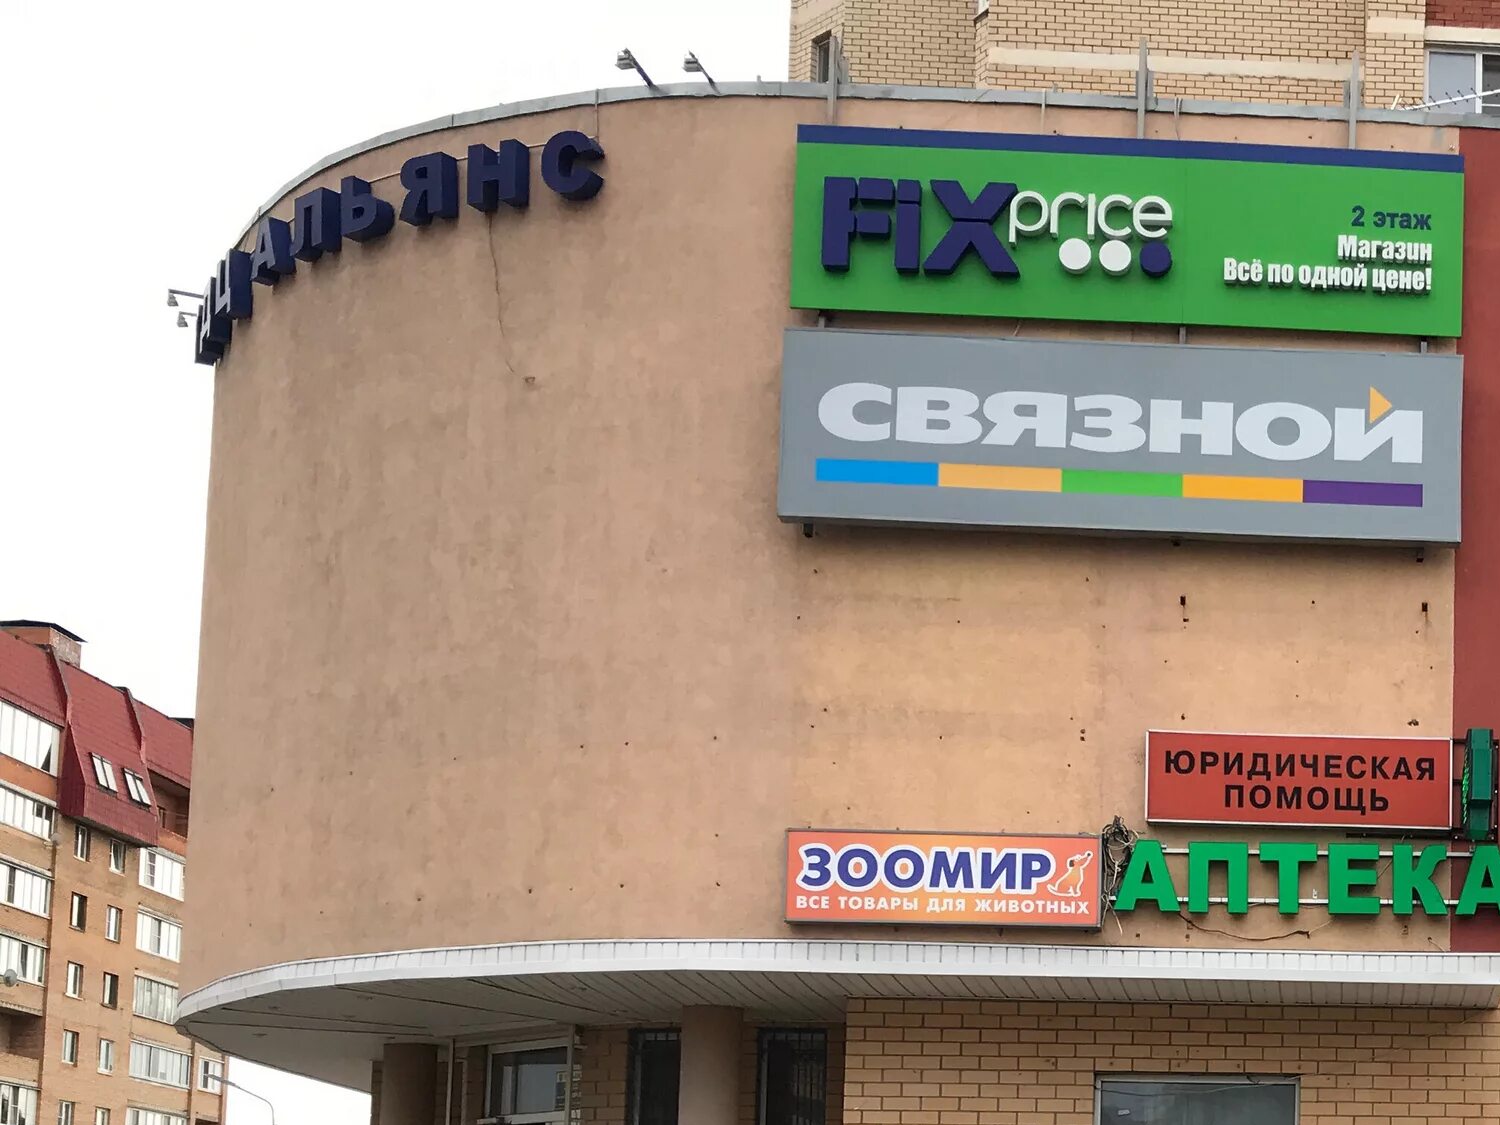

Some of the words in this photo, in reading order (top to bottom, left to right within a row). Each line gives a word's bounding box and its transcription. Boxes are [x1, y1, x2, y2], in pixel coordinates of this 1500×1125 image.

[249, 130, 605, 286] АЛЬЯНС
[1009, 190, 1173, 248] price
[1351, 205, 1366, 228] 2
[1373, 211, 1433, 231] этаж
[1337, 234, 1433, 263] Магазин
[1223, 257, 1263, 284] Всё
[1267, 263, 1294, 285] по
[1299, 263, 1368, 289] одной
[1372, 268, 1432, 292] цене!
[1164, 749, 1436, 783] ЮРИДИЧЕСКАЯ
[1223, 783, 1390, 815] ПОМОЩЬ
[799, 846, 1054, 892] ЗООМИР
[796, 896, 829, 909] ВСЕ
[838, 896, 918, 911] ТОВАРЫ
[926, 898, 965, 913] ДЛЯ
[974, 898, 1089, 914] ЖИВОТНЫХ
